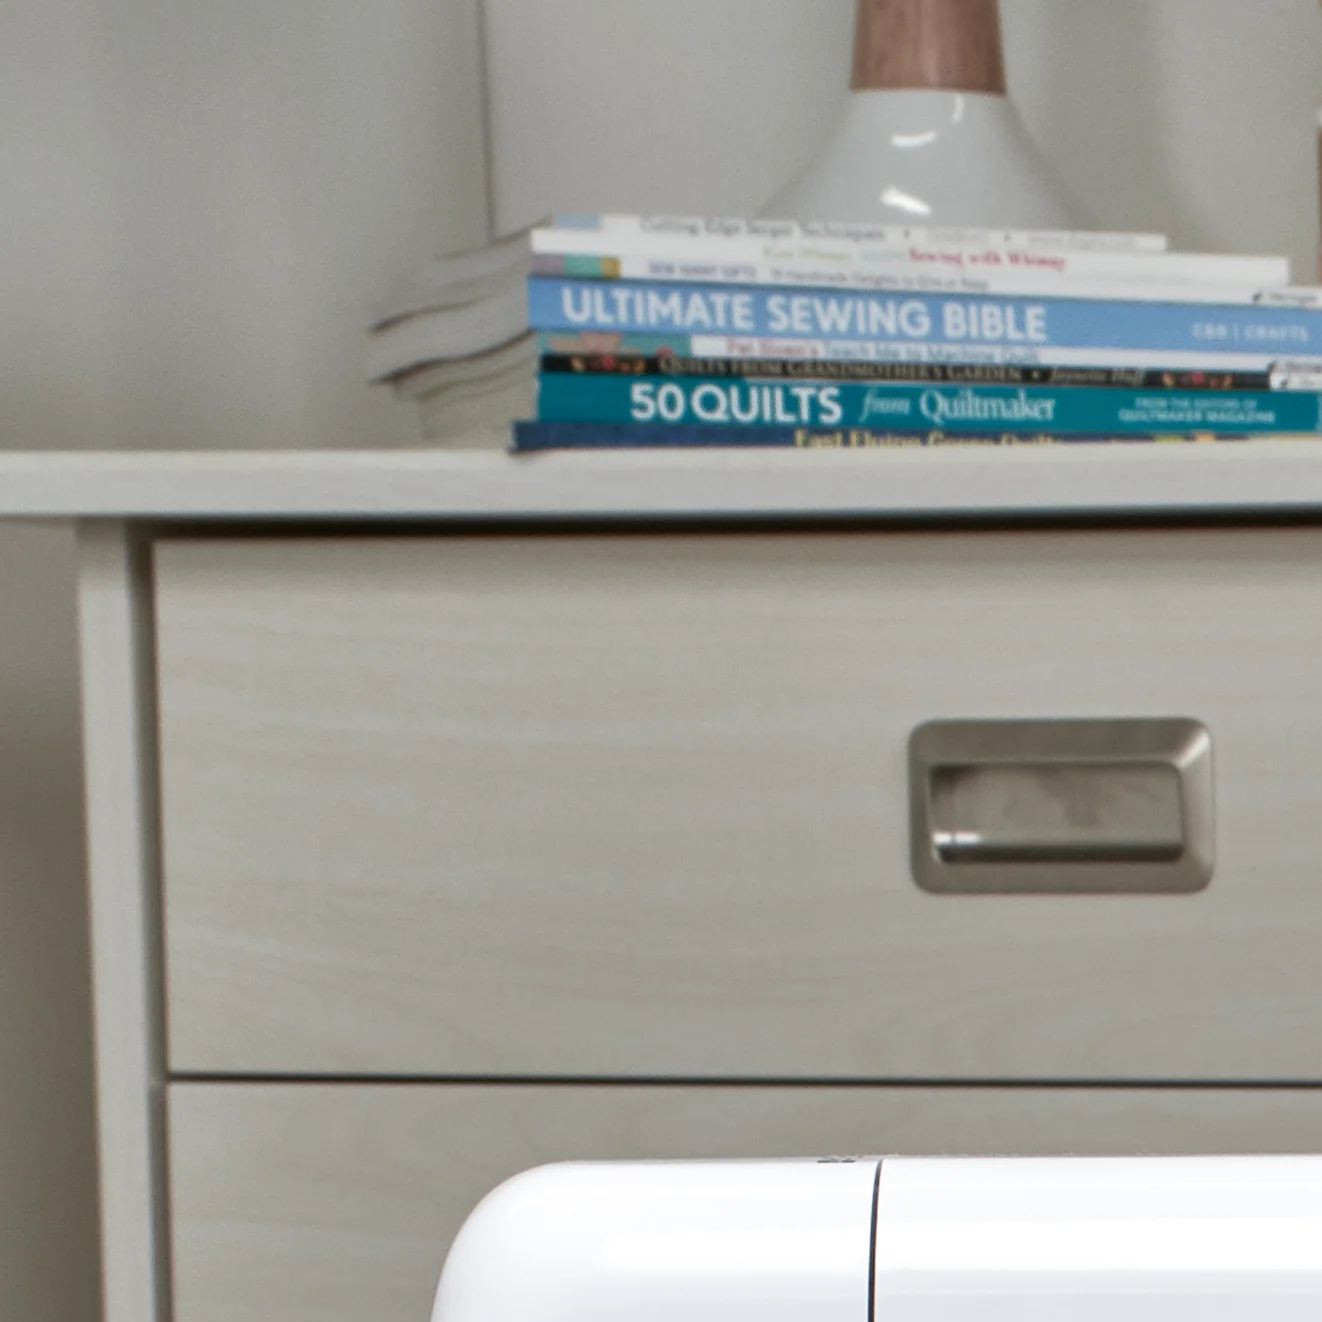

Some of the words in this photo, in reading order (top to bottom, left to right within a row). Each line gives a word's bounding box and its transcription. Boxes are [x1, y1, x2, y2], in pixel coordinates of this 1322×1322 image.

[562, 287, 754, 330] ULTIMATE
[767, 296, 933, 338] SEWING
[943, 302, 1048, 342] BIBLE
[630, 382, 685, 422] 50
[691, 384, 842, 424] QUILTS
[858, 386, 912, 424] from
[919, 387, 1056, 426] Quiltmaker
